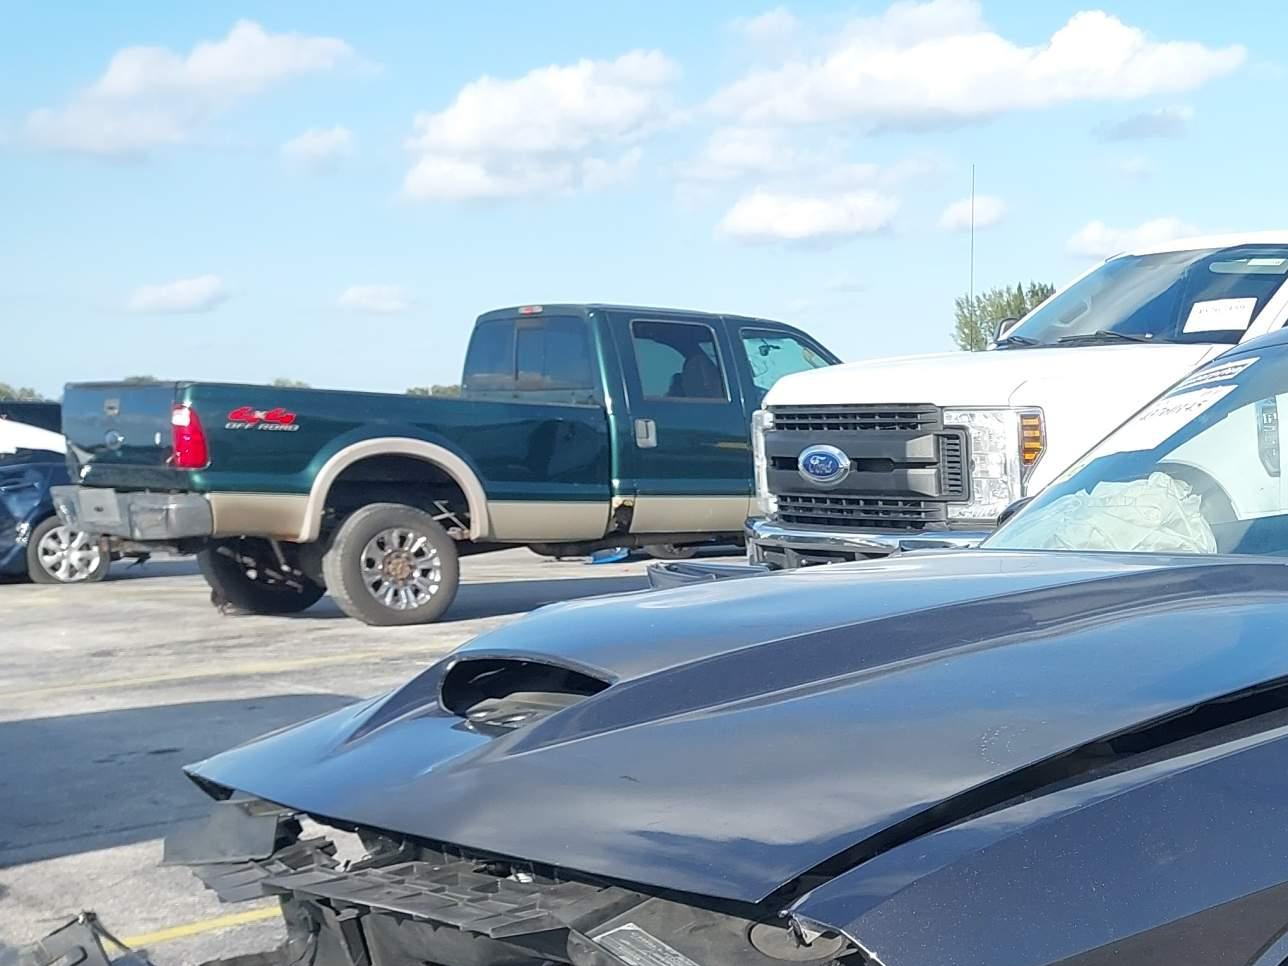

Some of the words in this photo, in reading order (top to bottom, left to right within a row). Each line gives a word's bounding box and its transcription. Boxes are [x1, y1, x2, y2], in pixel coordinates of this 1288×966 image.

[224, 422, 256, 430] OFF
[258, 423, 300, 432] ROAD
[809, 455, 833, 474] Ford
